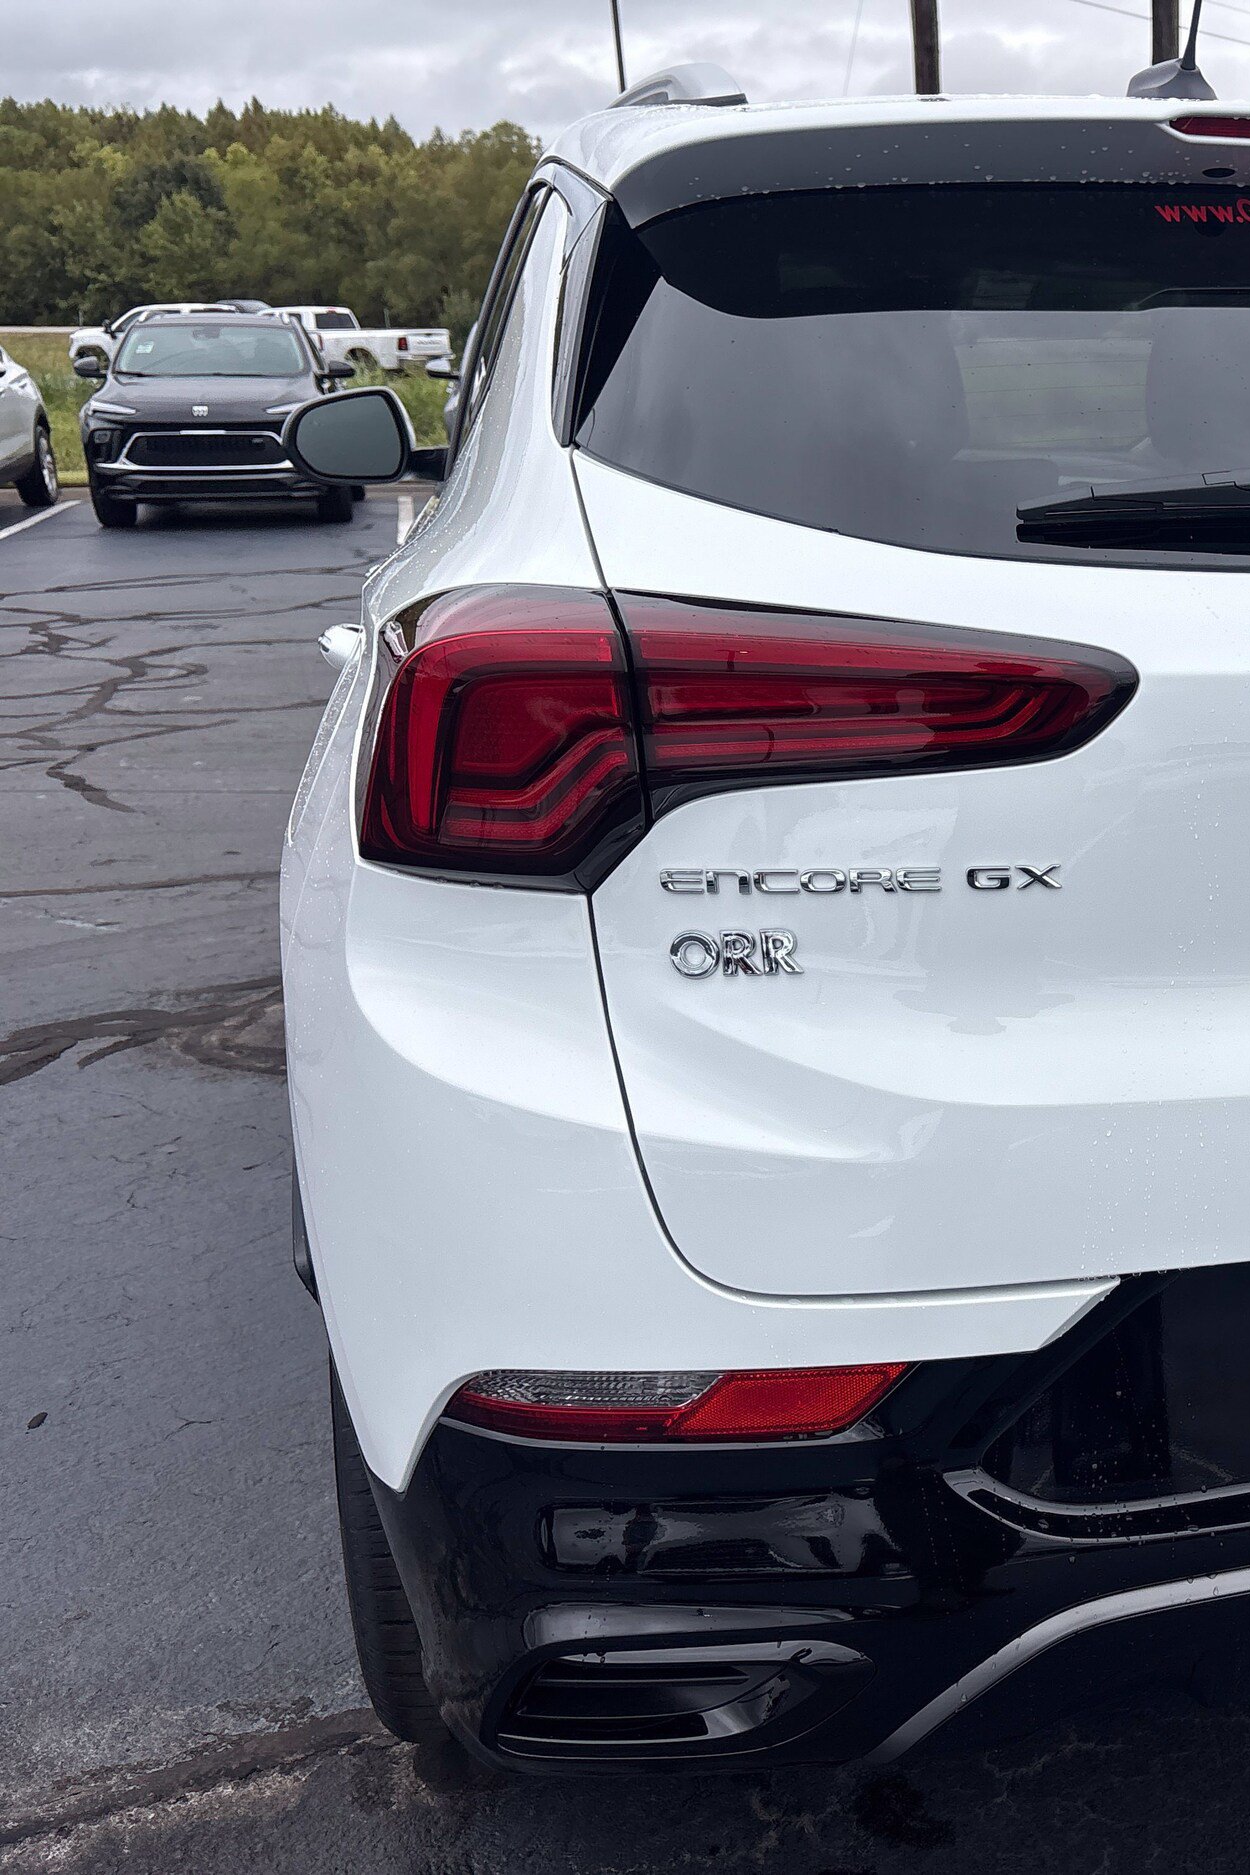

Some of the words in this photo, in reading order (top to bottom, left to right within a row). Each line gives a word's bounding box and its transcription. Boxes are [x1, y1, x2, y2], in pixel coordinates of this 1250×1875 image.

[659, 867, 942, 895] ENCORE
[966, 863, 1062, 890] GX
[669, 927, 804, 980] ORR
